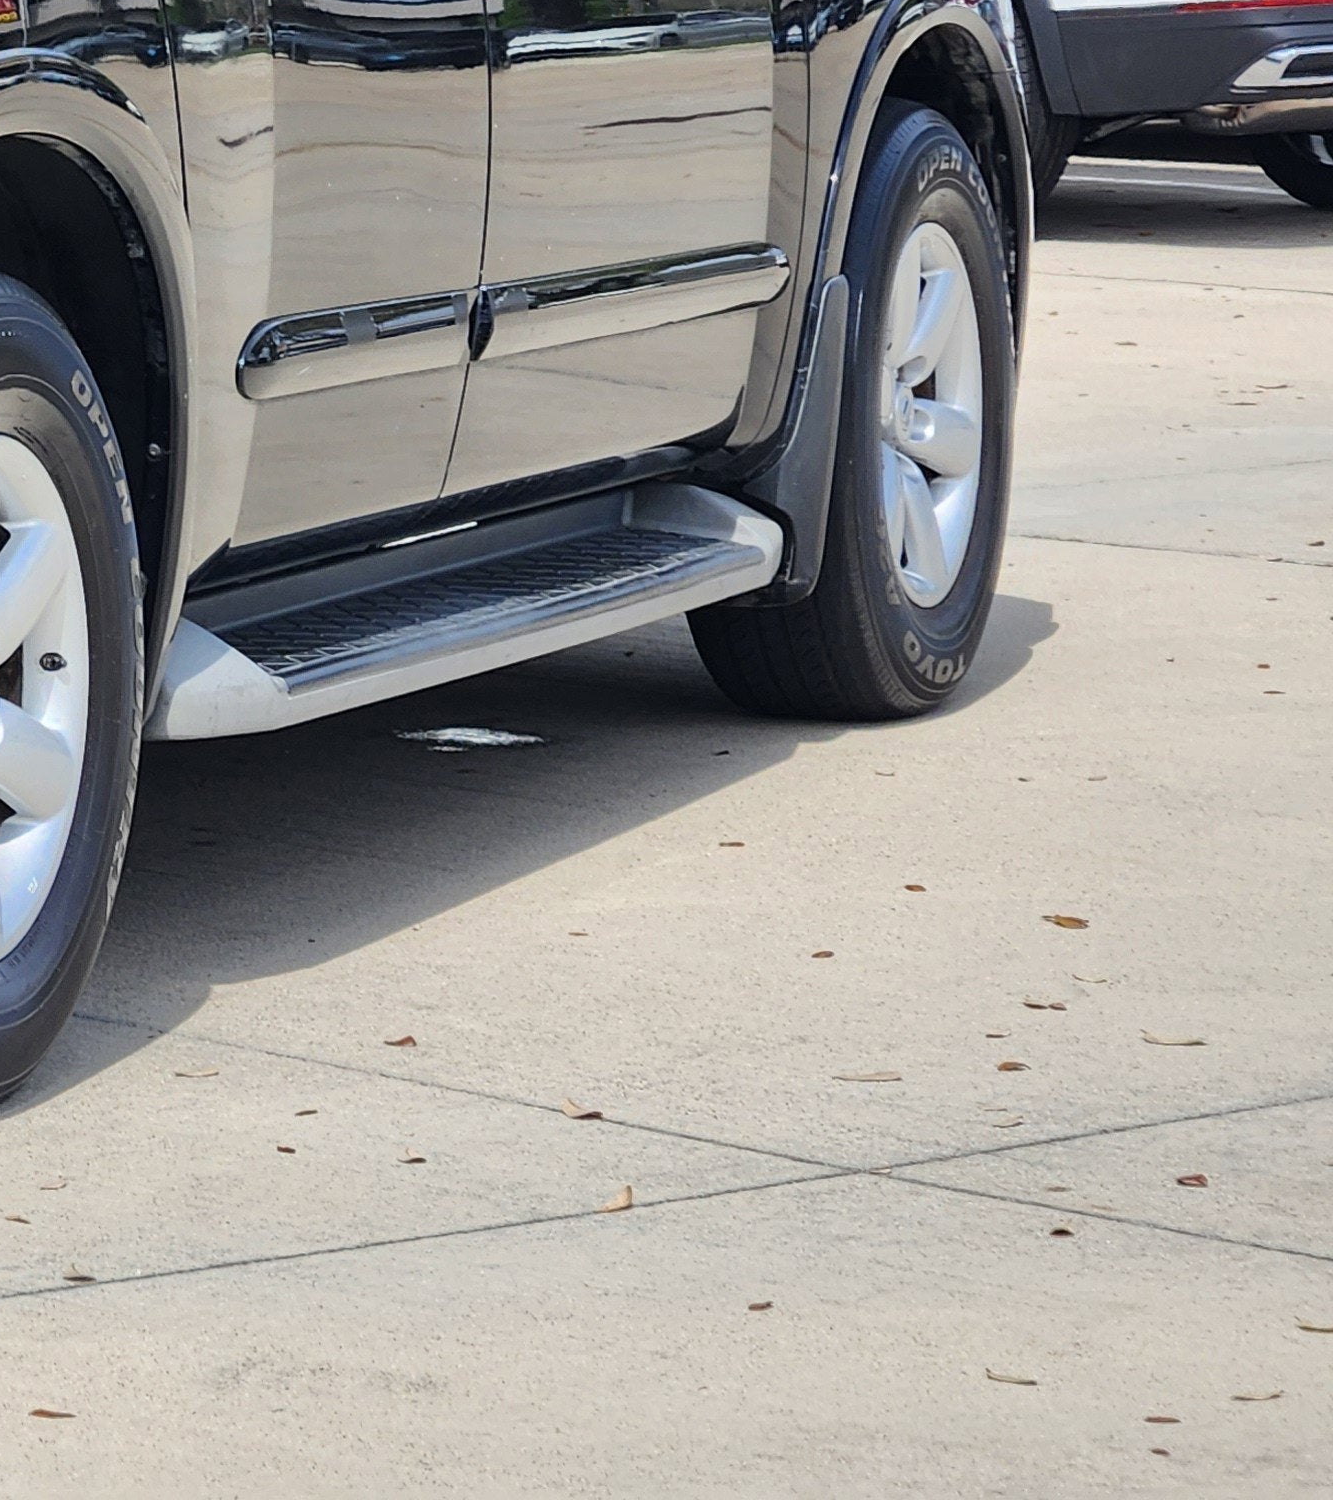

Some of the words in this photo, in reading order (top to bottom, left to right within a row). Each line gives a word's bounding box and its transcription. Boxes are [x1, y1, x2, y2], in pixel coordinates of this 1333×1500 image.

[917, 144, 963, 193] OPEN
[71, 369, 133, 525] OPEN
[903, 629, 966, 684] TOYO
